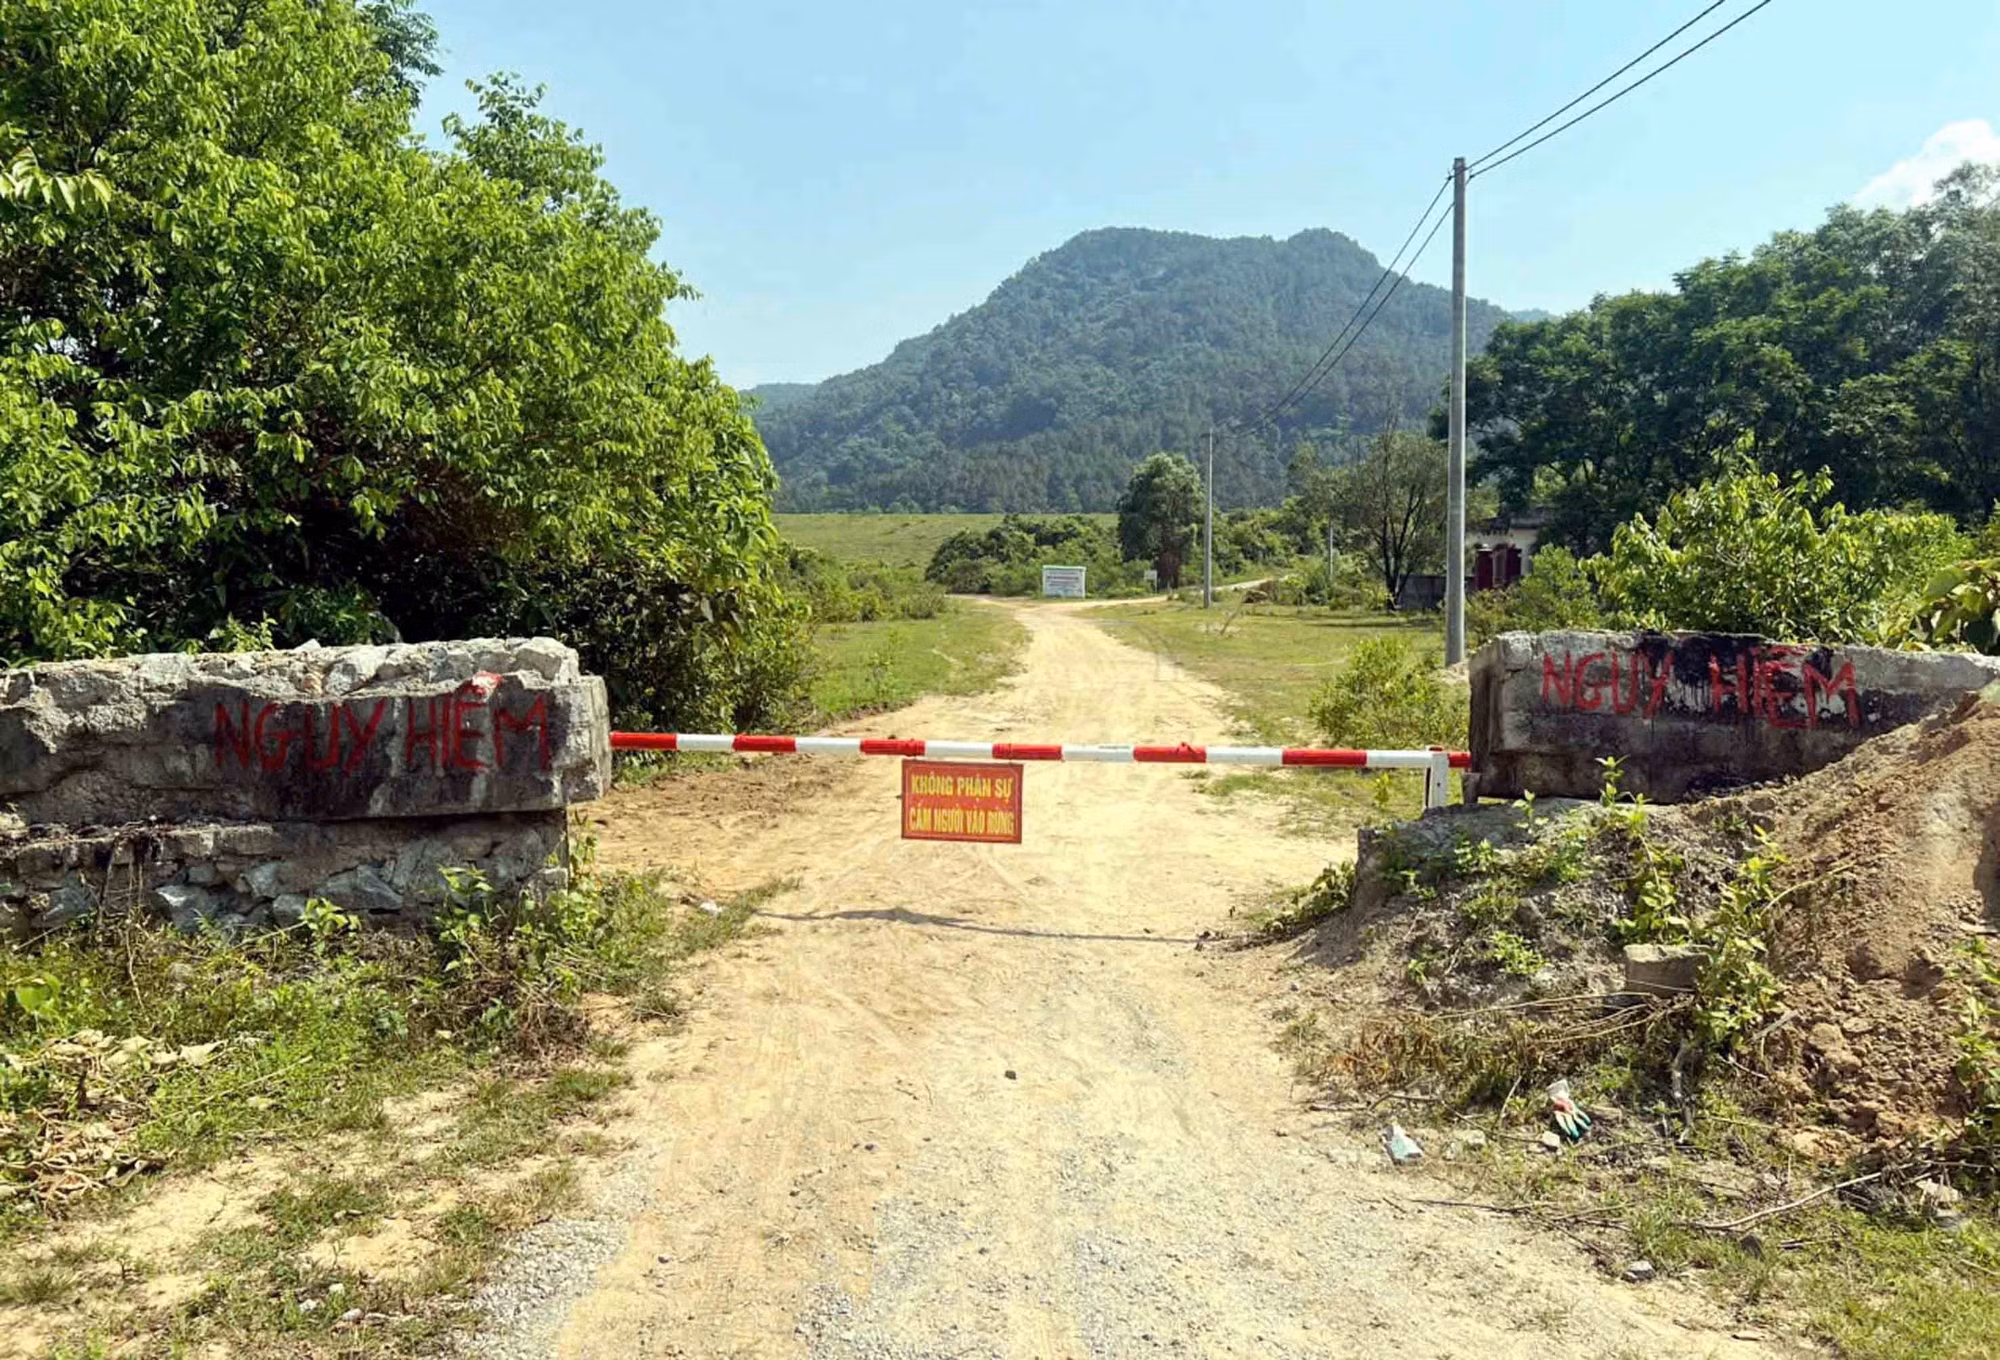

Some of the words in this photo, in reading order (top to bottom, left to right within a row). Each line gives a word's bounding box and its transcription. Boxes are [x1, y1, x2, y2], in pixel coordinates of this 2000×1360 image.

[1542, 646, 1674, 723] NGUY
[213, 697, 387, 778] NGUY
[911, 771, 953, 796] KHÔNG
[957, 773, 991, 802] PHẬN
[994, 776, 1013, 804] SỰ
[909, 799, 932, 833] CẤM
